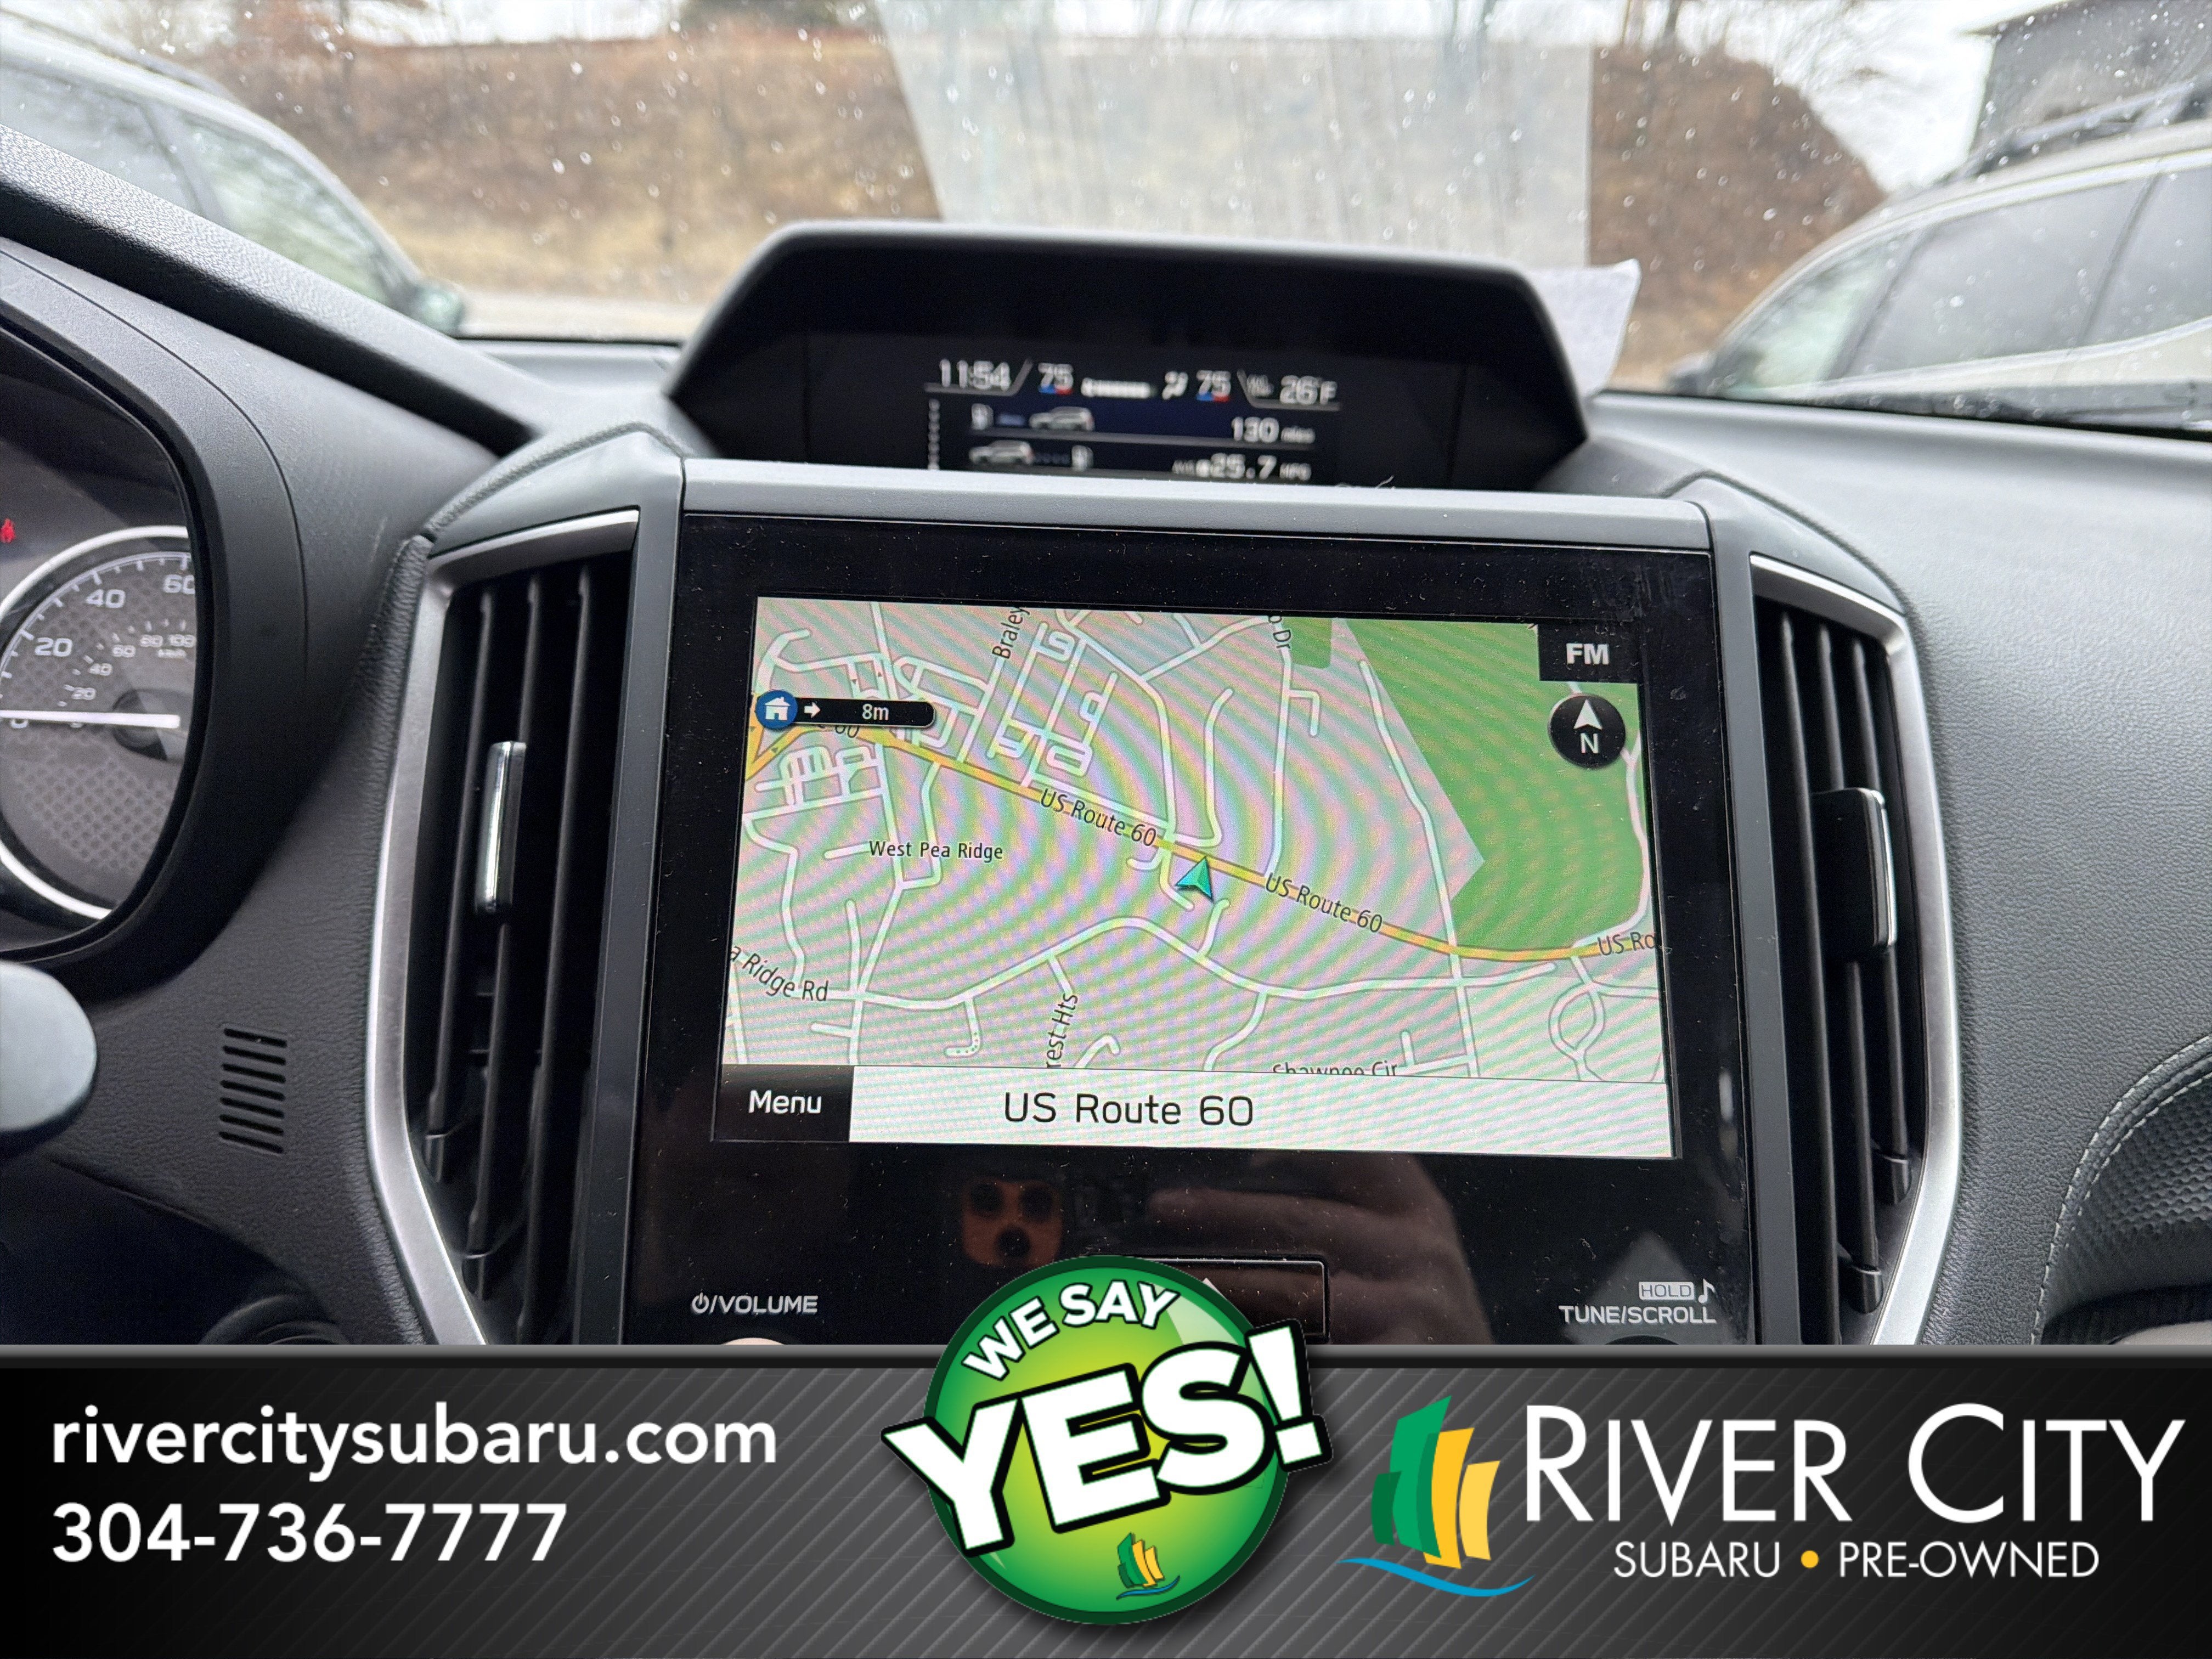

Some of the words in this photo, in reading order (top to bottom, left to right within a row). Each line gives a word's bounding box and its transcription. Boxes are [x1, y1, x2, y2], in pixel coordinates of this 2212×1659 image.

[1038, 362, 1074, 391] 75
[1196, 370, 1231, 398] 75
[1232, 416, 1279, 443] 130
[86, 589, 126, 608] 40
[992, 607, 1030, 659] Braley
[1273, 629, 1291, 649] Dr
[35, 637, 72, 657] 20
[1566, 644, 1609, 664] FM
[88, 663, 112, 676] 40
[862, 704, 889, 720] 8m
[1581, 733, 1599, 754] N
[1041, 788, 1068, 812] US
[1071, 800, 1125, 836] Route
[1131, 823, 1156, 846] 60
[869, 840, 912, 857] West
[920, 841, 951, 859] Pea
[958, 842, 1003, 864] Ridge
[1266, 872, 1292, 898] US
[1296, 885, 1351, 922] Route
[1357, 910, 1383, 933] 60
[1597, 934, 1624, 956] US
[742, 952, 795, 997] Ridge
[802, 980, 829, 1001] Rd
[1052, 994, 1078, 1025] Hts
[748, 1090, 822, 1115] Menu
[1005, 1092, 1057, 1123] US
[1075, 1093, 1181, 1125] Route
[1199, 1096, 1254, 1126] 60
[1640, 1284, 1692, 1297] HOLD
[1558, 1305, 1717, 1324] TUNE/SCROLL
